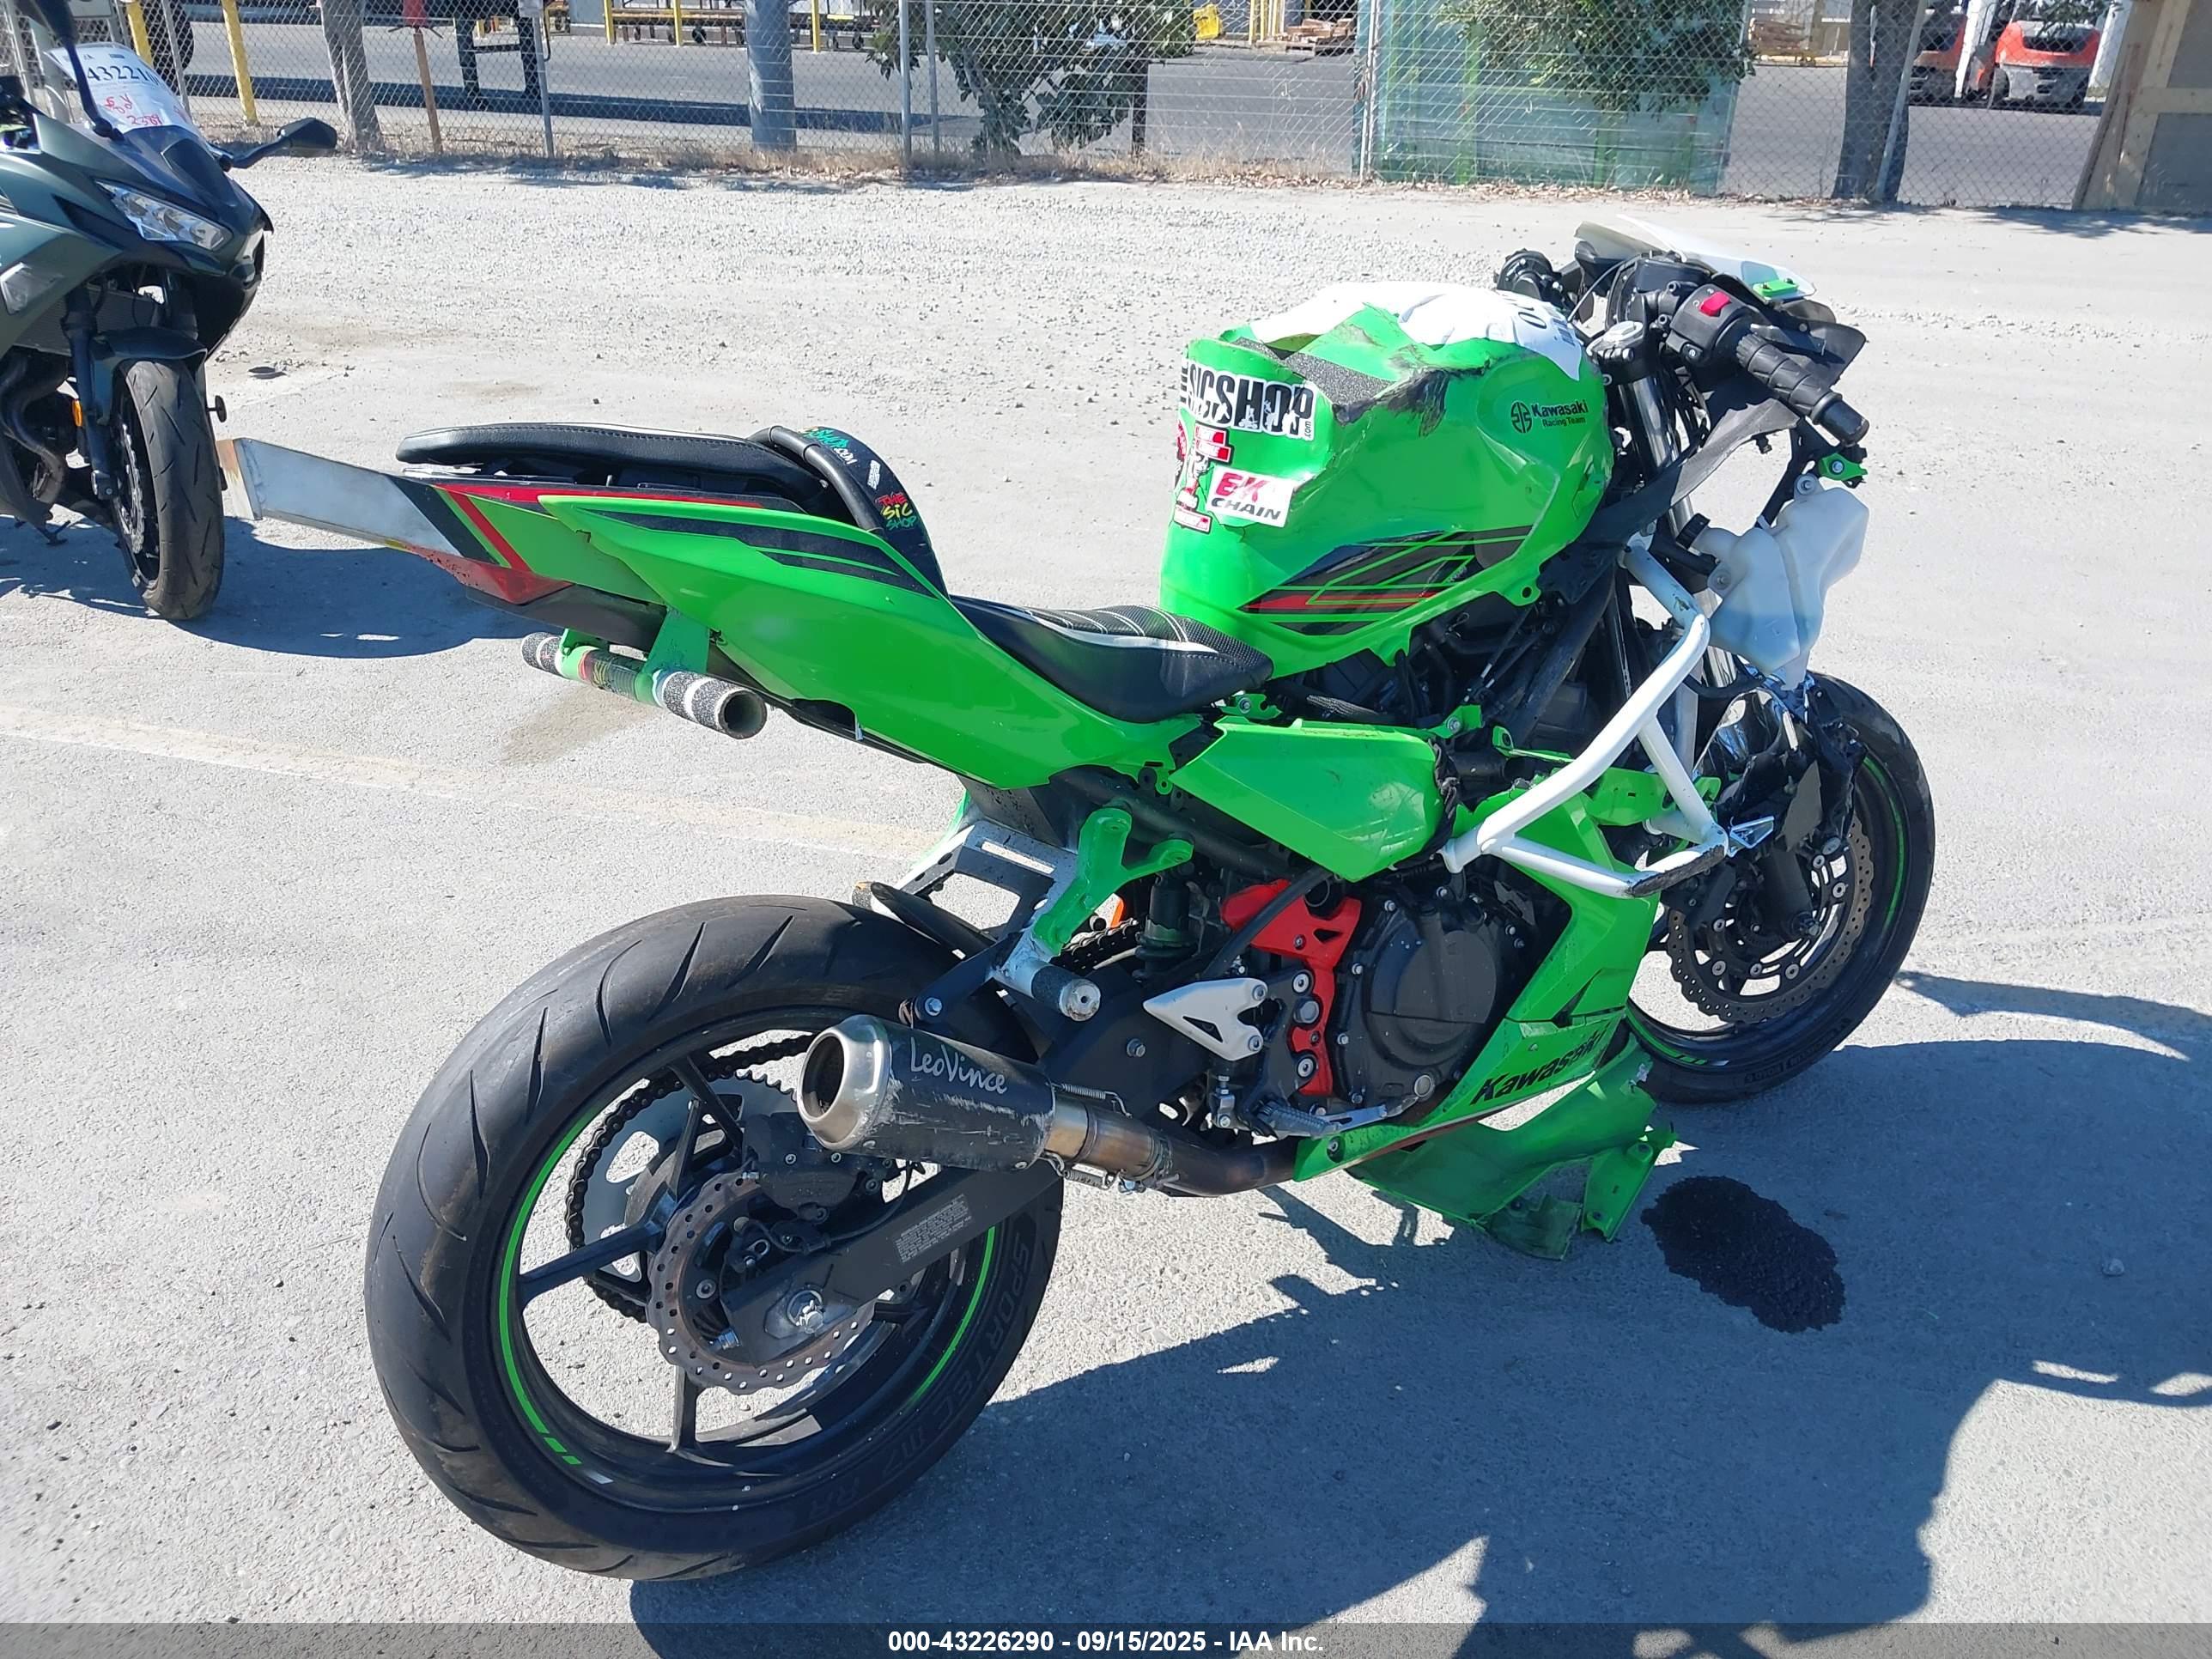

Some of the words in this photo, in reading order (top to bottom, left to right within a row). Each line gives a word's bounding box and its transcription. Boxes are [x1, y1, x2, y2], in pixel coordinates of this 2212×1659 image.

[1531, 399, 1589, 417] Kawasaki
[1542, 418, 1567, 427] Racing
[1568, 416, 1586, 425] Team
[1216, 471, 1271, 503] EK
[1211, 497, 1282, 520] CHAIN
[910, 1036, 1008, 1094] LeoVince
